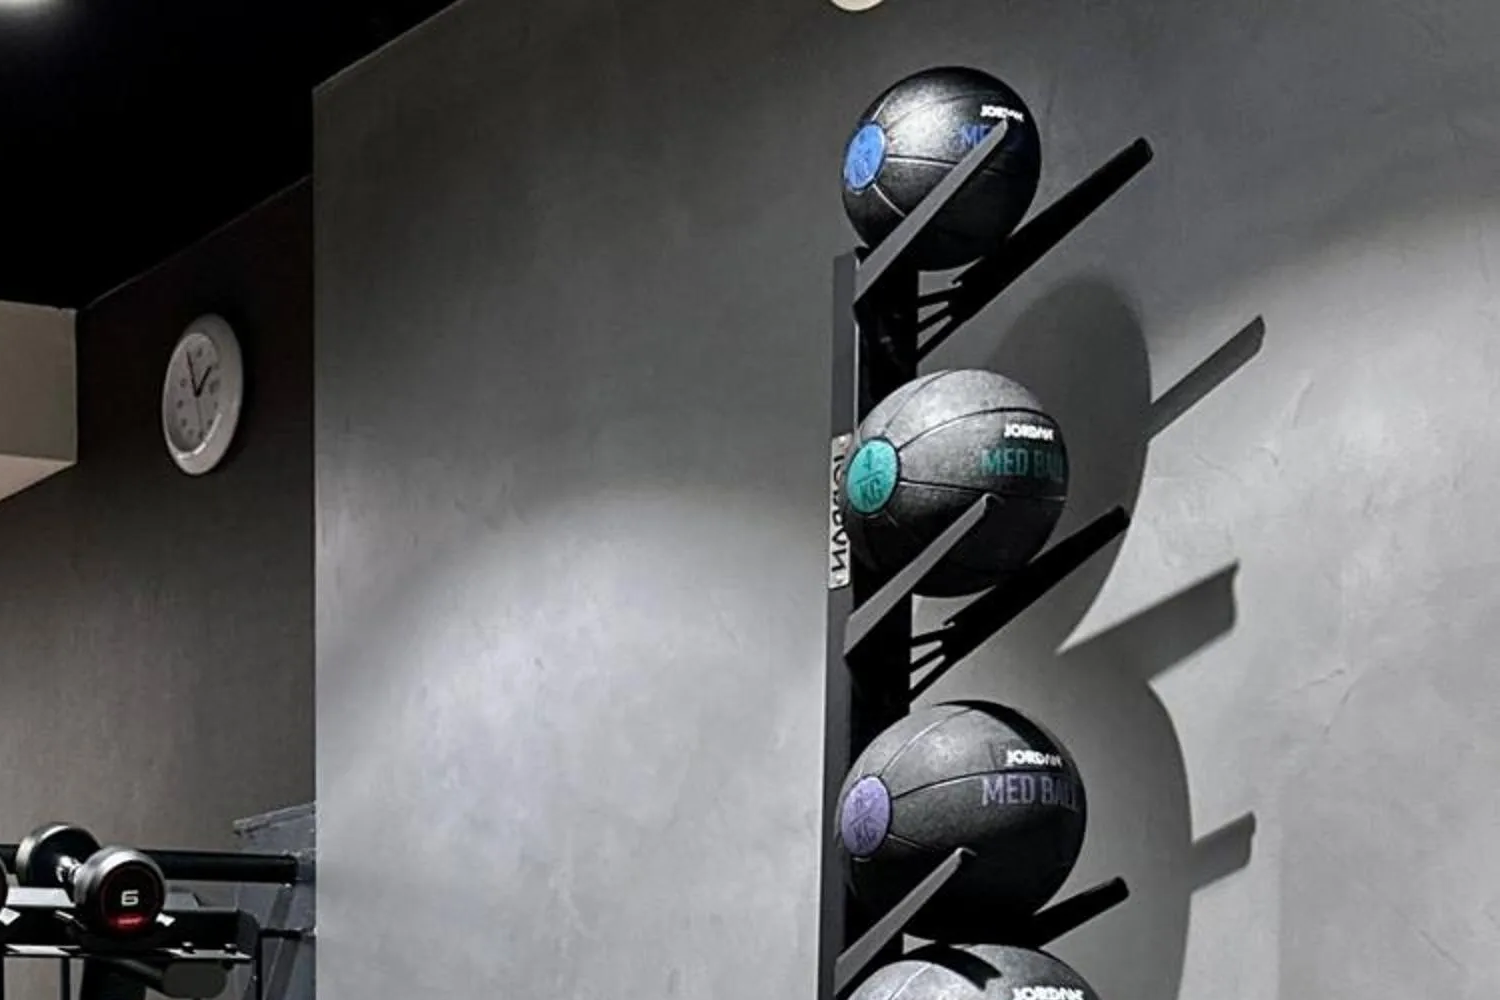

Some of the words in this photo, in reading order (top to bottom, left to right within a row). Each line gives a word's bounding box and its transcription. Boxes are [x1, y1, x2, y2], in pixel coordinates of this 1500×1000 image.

[981, 447, 1029, 477] MED
[981, 774, 1035, 807] MED
[120, 889, 140, 906] 6
